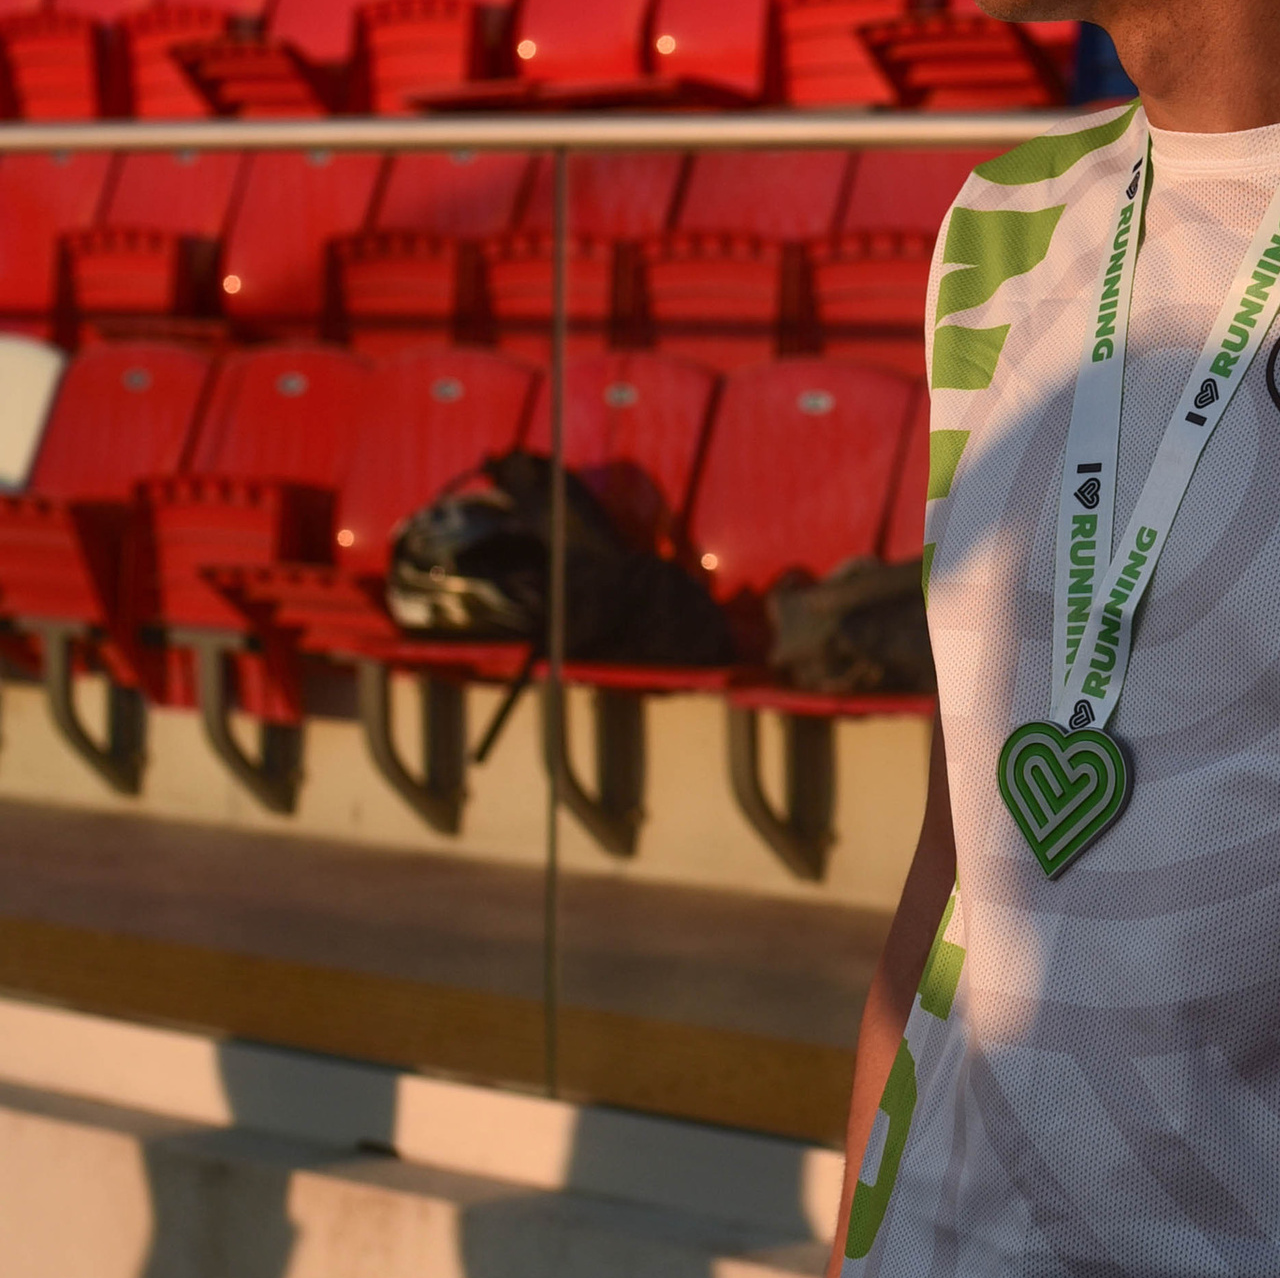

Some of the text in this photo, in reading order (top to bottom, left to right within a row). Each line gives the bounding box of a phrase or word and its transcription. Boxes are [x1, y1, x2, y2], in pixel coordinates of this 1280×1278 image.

[1092, 156, 1143, 363] I RUNNING
[1185, 411, 1207, 426] I
[1064, 462, 1102, 687] I RUNNI
[1081, 526, 1158, 699] RUNNING
